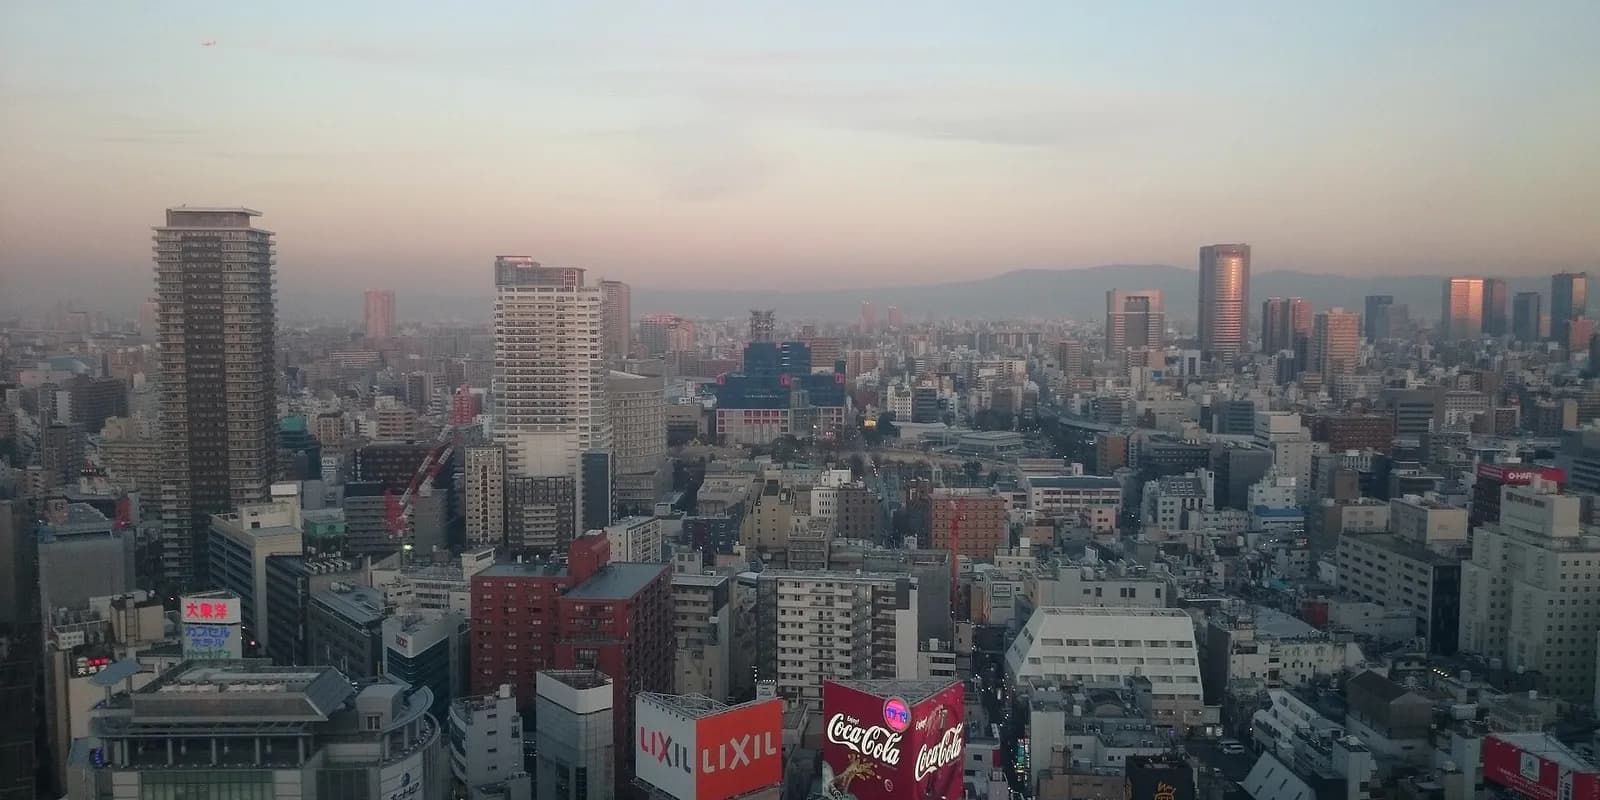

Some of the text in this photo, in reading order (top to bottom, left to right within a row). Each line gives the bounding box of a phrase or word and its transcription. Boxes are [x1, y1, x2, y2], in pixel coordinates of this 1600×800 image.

[186, 602, 227, 619] 大東洋
[640, 726, 692, 774] LIXIL
[702, 731, 777, 774] LIXIL
[827, 713, 903, 765] Coca-Cola
[915, 721, 964, 781] Coca-Cola
